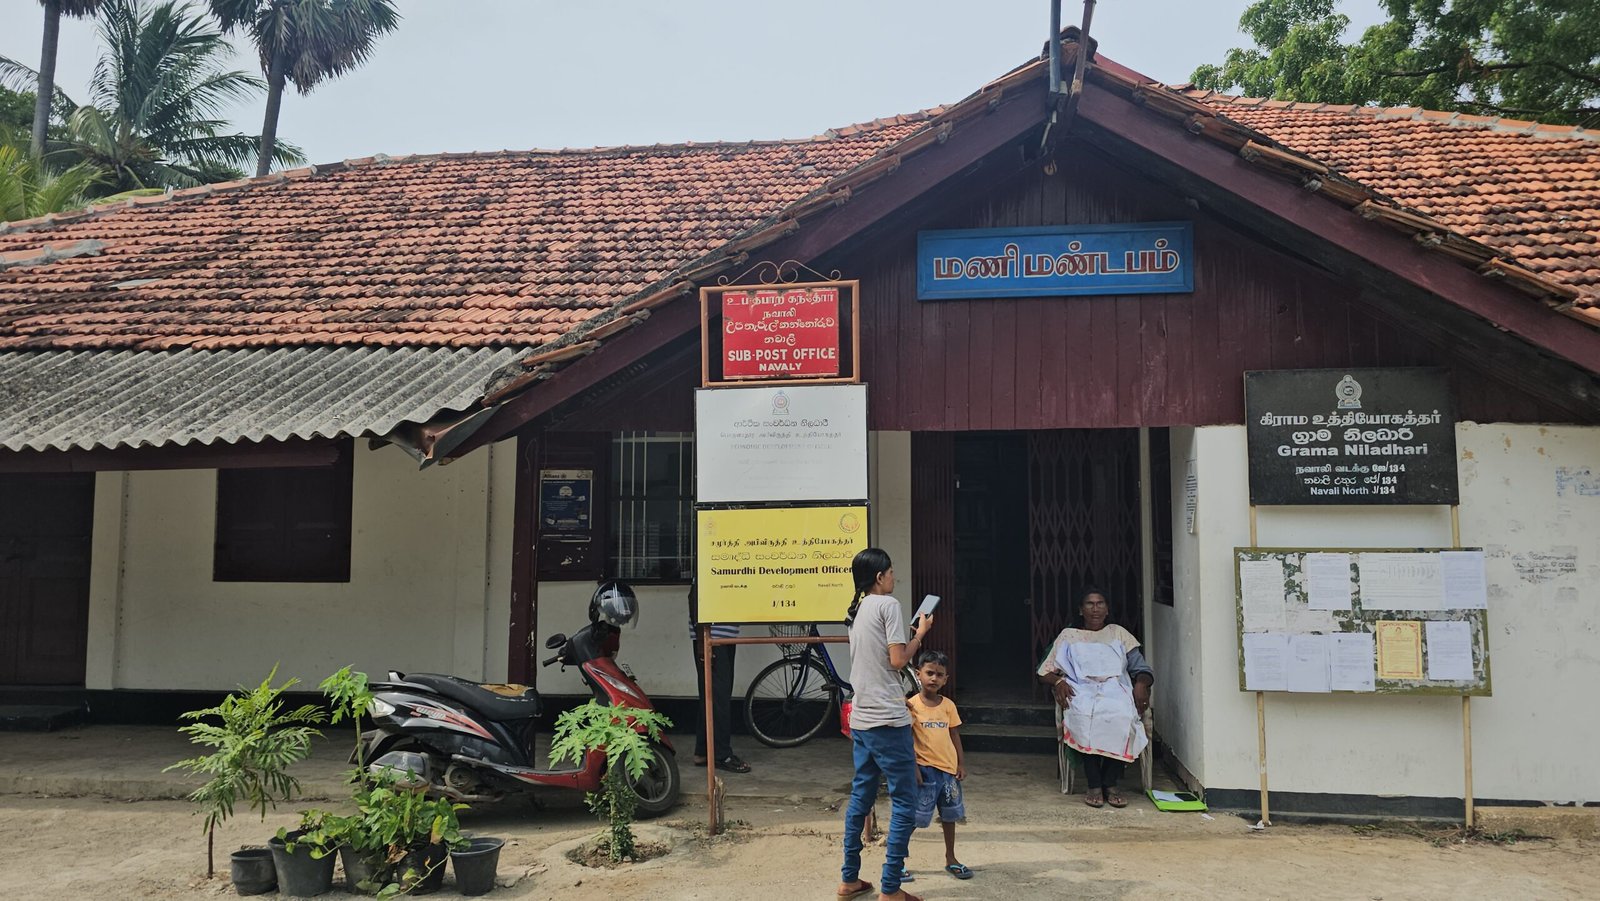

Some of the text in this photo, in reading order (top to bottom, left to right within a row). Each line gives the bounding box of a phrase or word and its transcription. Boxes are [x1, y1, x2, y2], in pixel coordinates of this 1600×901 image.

[762, 307, 797, 320] நவாலி
[728, 347, 836, 361] SUB-POST OFFICE
[759, 362, 802, 372] NAVALY
[1260, 409, 1442, 427] கிராம உத்தியோகத்தர்
[1277, 443, 1428, 457] Grama Niladhari
[1295, 463, 1332, 475] நவாலி
[1334, 463, 1370, 473] வடக்கு
[1310, 486, 1340, 495] Navali
[1342, 486, 1369, 495] North
[711, 564, 853, 577] Samurdhi Development Officer
[771, 599, 796, 608] J/134
